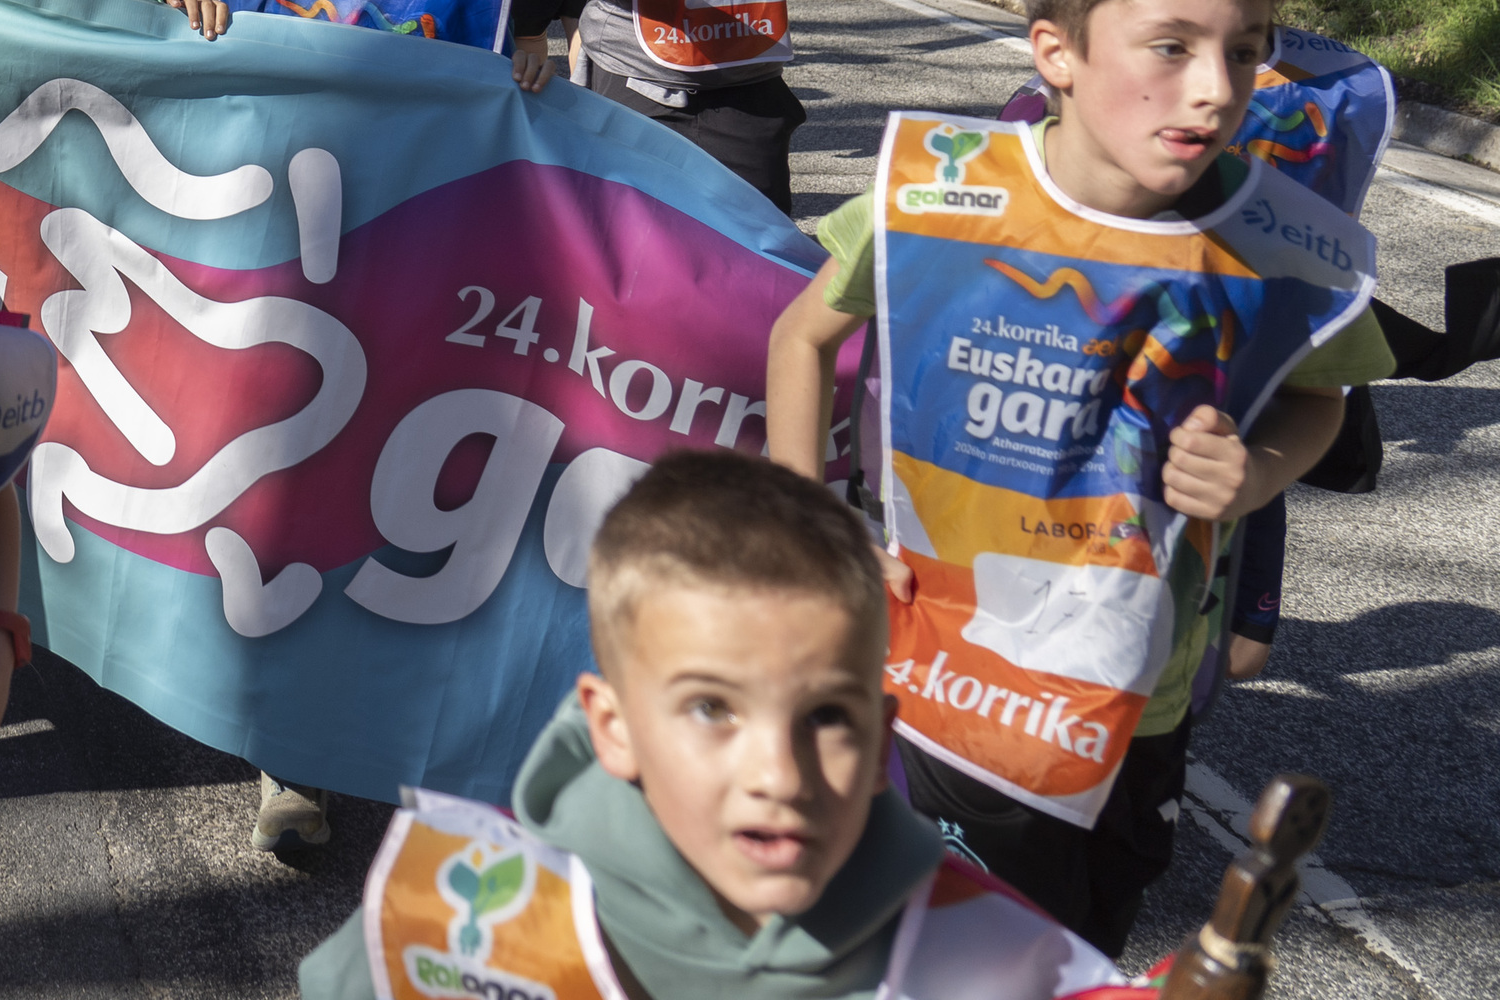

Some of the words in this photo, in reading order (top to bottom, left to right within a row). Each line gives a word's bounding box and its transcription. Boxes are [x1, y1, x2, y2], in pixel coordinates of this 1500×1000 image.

[653, 12, 775, 45] 24.korrika
[906, 189, 1002, 210] goiener
[1280, 219, 1353, 272] eitb
[971, 315, 1079, 353] 24.korrika
[947, 335, 1111, 396] Euskara
[2, 389, 45, 429] eitb
[964, 381, 1102, 442] gara
[883, 648, 1111, 765] 4.korrika
